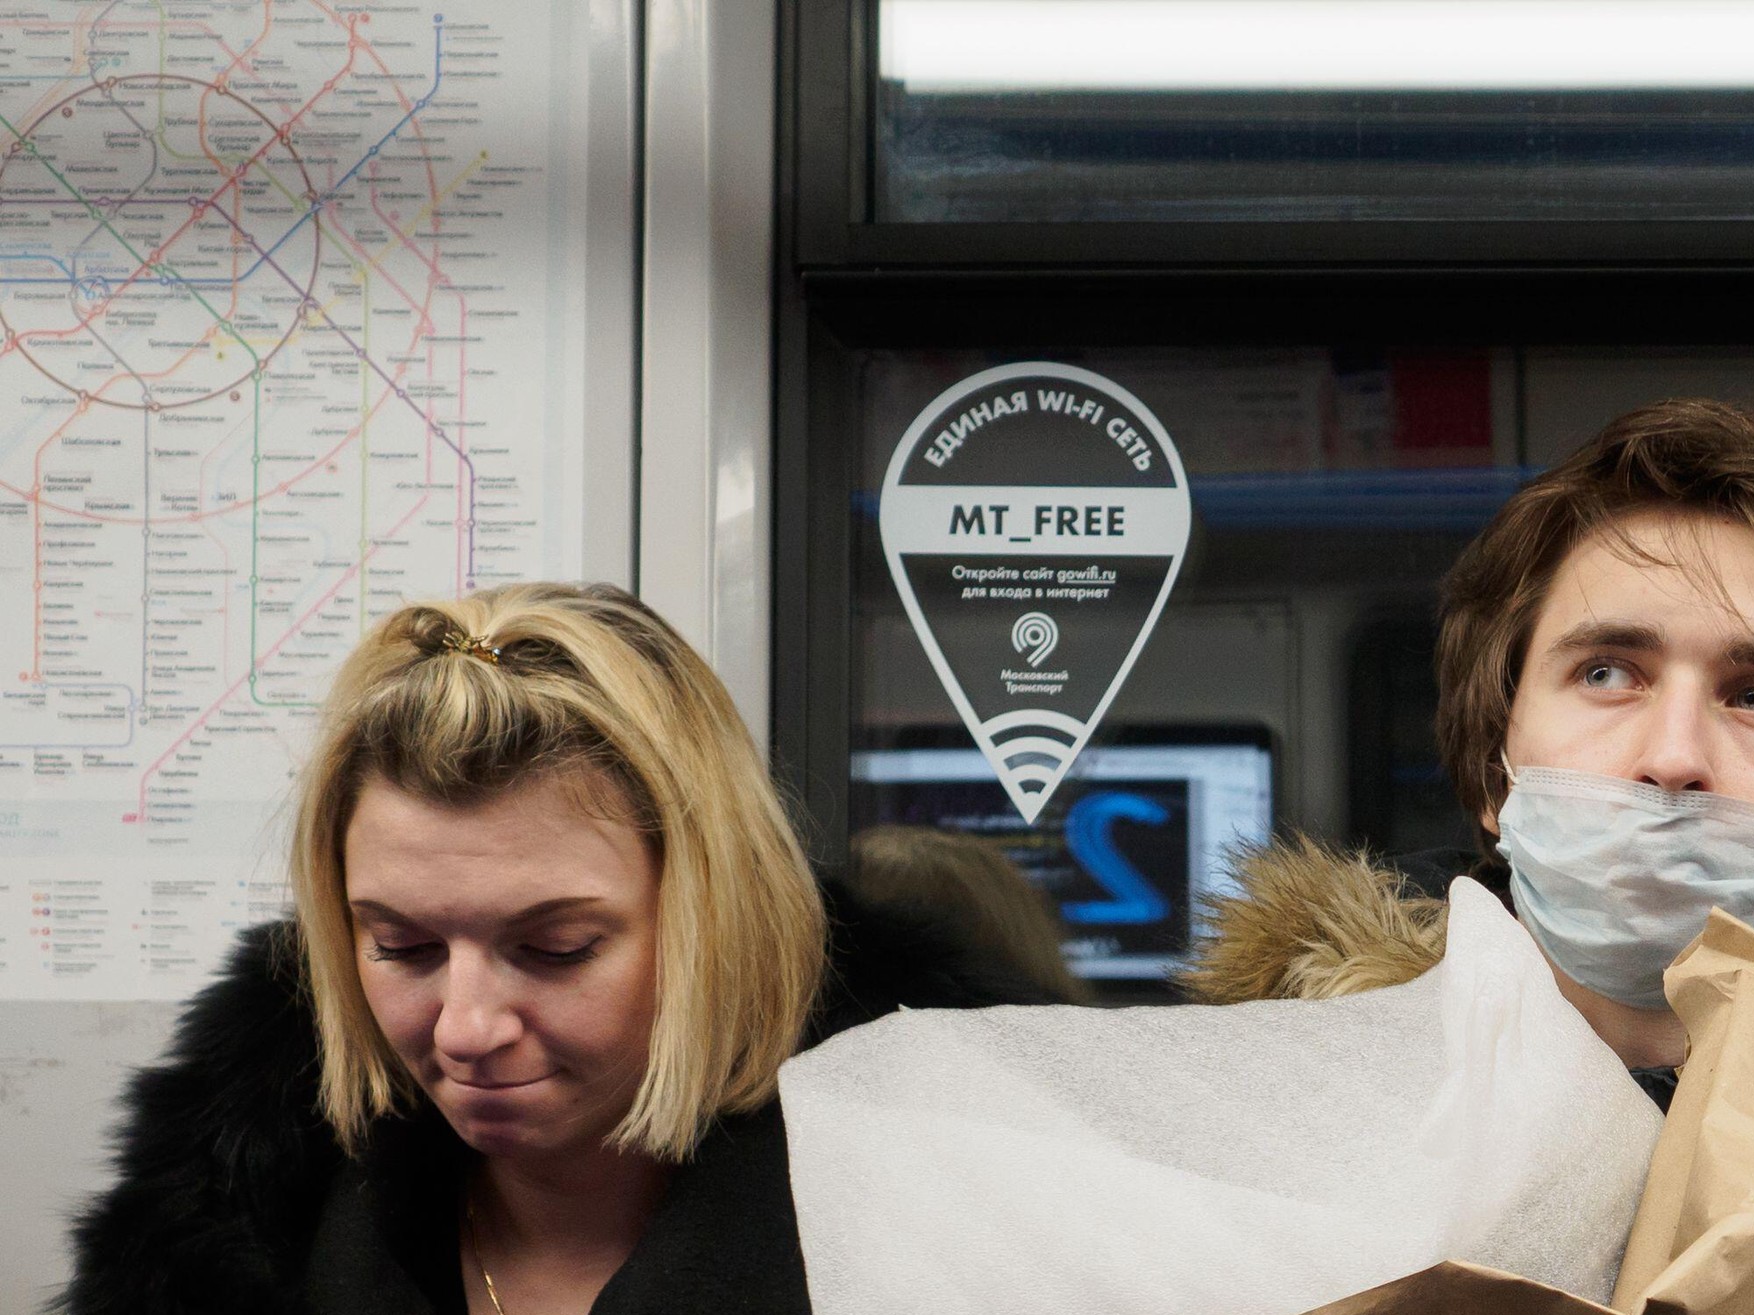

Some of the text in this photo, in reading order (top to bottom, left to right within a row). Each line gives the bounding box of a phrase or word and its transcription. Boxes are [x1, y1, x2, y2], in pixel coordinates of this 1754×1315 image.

[924, 389, 1153, 472] ЕДИНАЯ WI-FI СЕТЬ
[948, 504, 1125, 542] MT_FREE
[952, 565, 1116, 584] Откройте сайт gowifi.ru
[961, 587, 1110, 602] для входа в интернет
[1000, 669, 1069, 681] Московский
[1005, 682, 1063, 695] Транспорт
